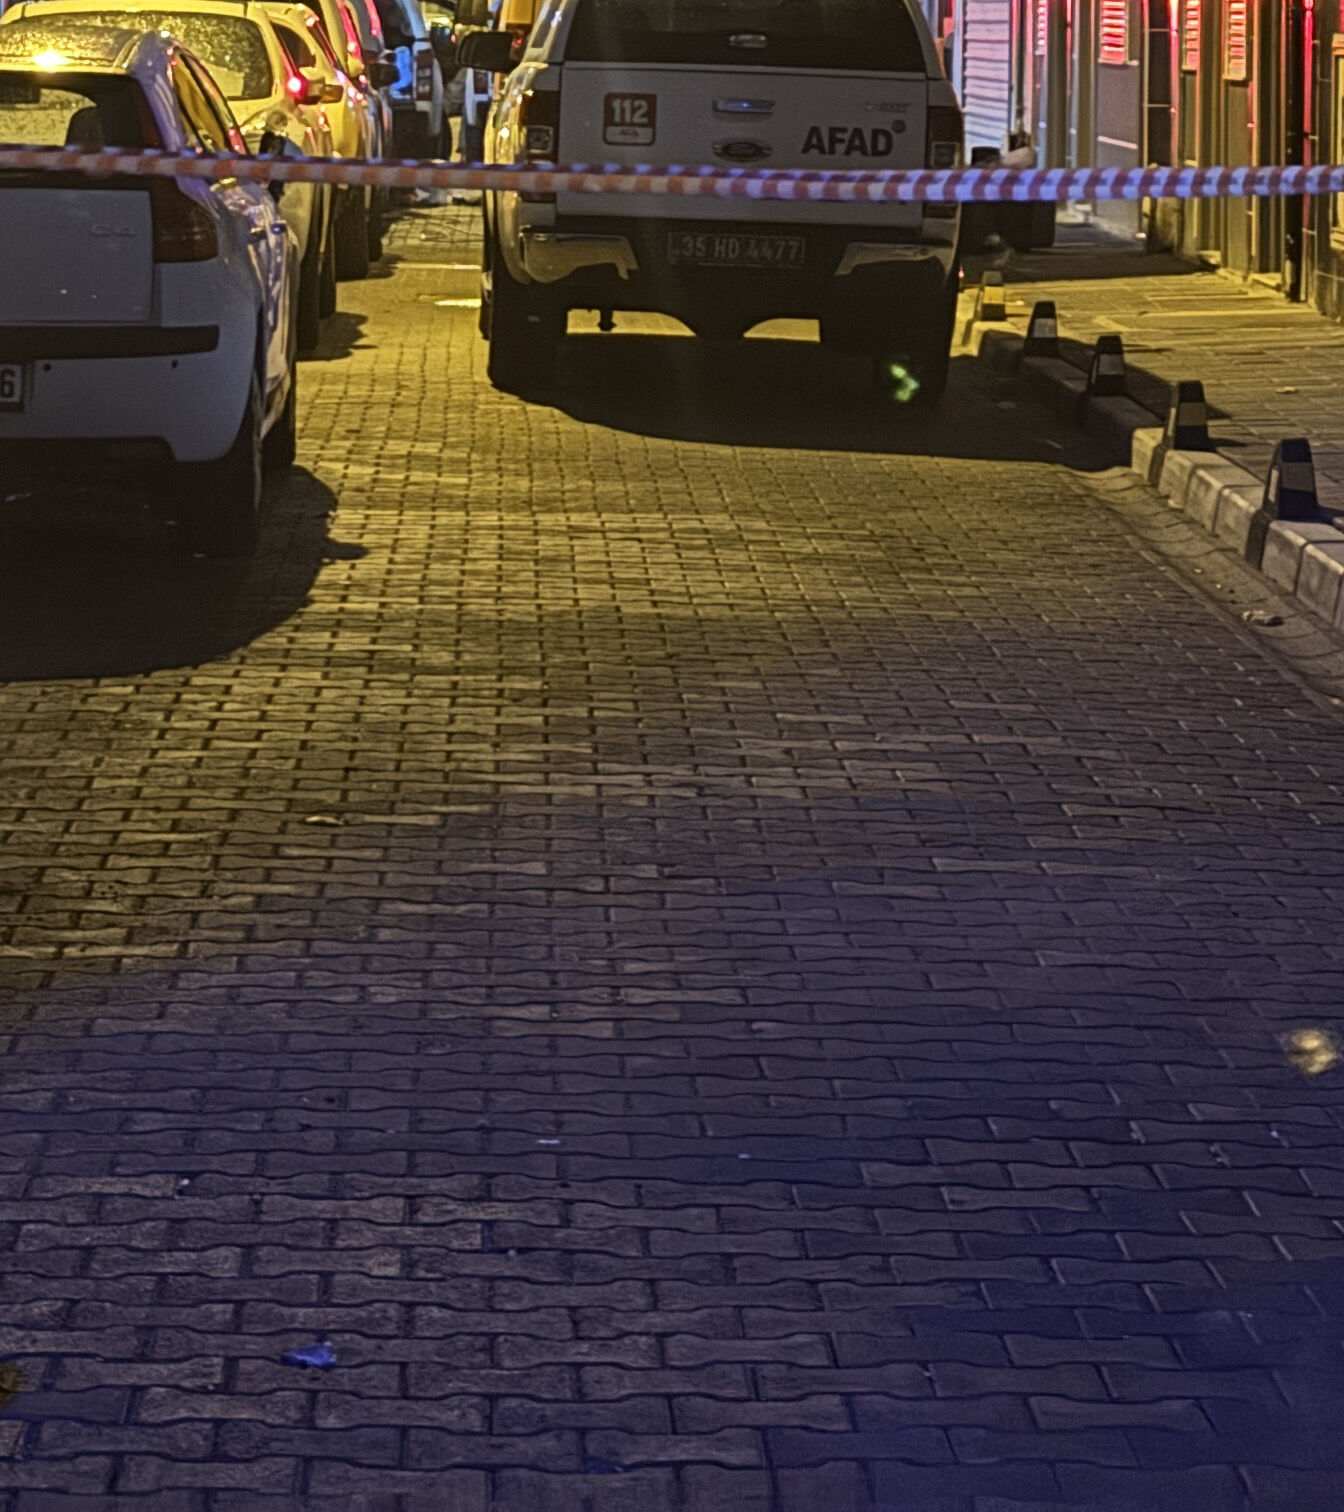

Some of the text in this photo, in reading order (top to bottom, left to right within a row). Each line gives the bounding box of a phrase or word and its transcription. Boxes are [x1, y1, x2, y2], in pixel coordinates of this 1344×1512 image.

[612, 99, 648, 123] 112
[801, 125, 894, 156] AFAD
[682, 235, 706, 257] 35
